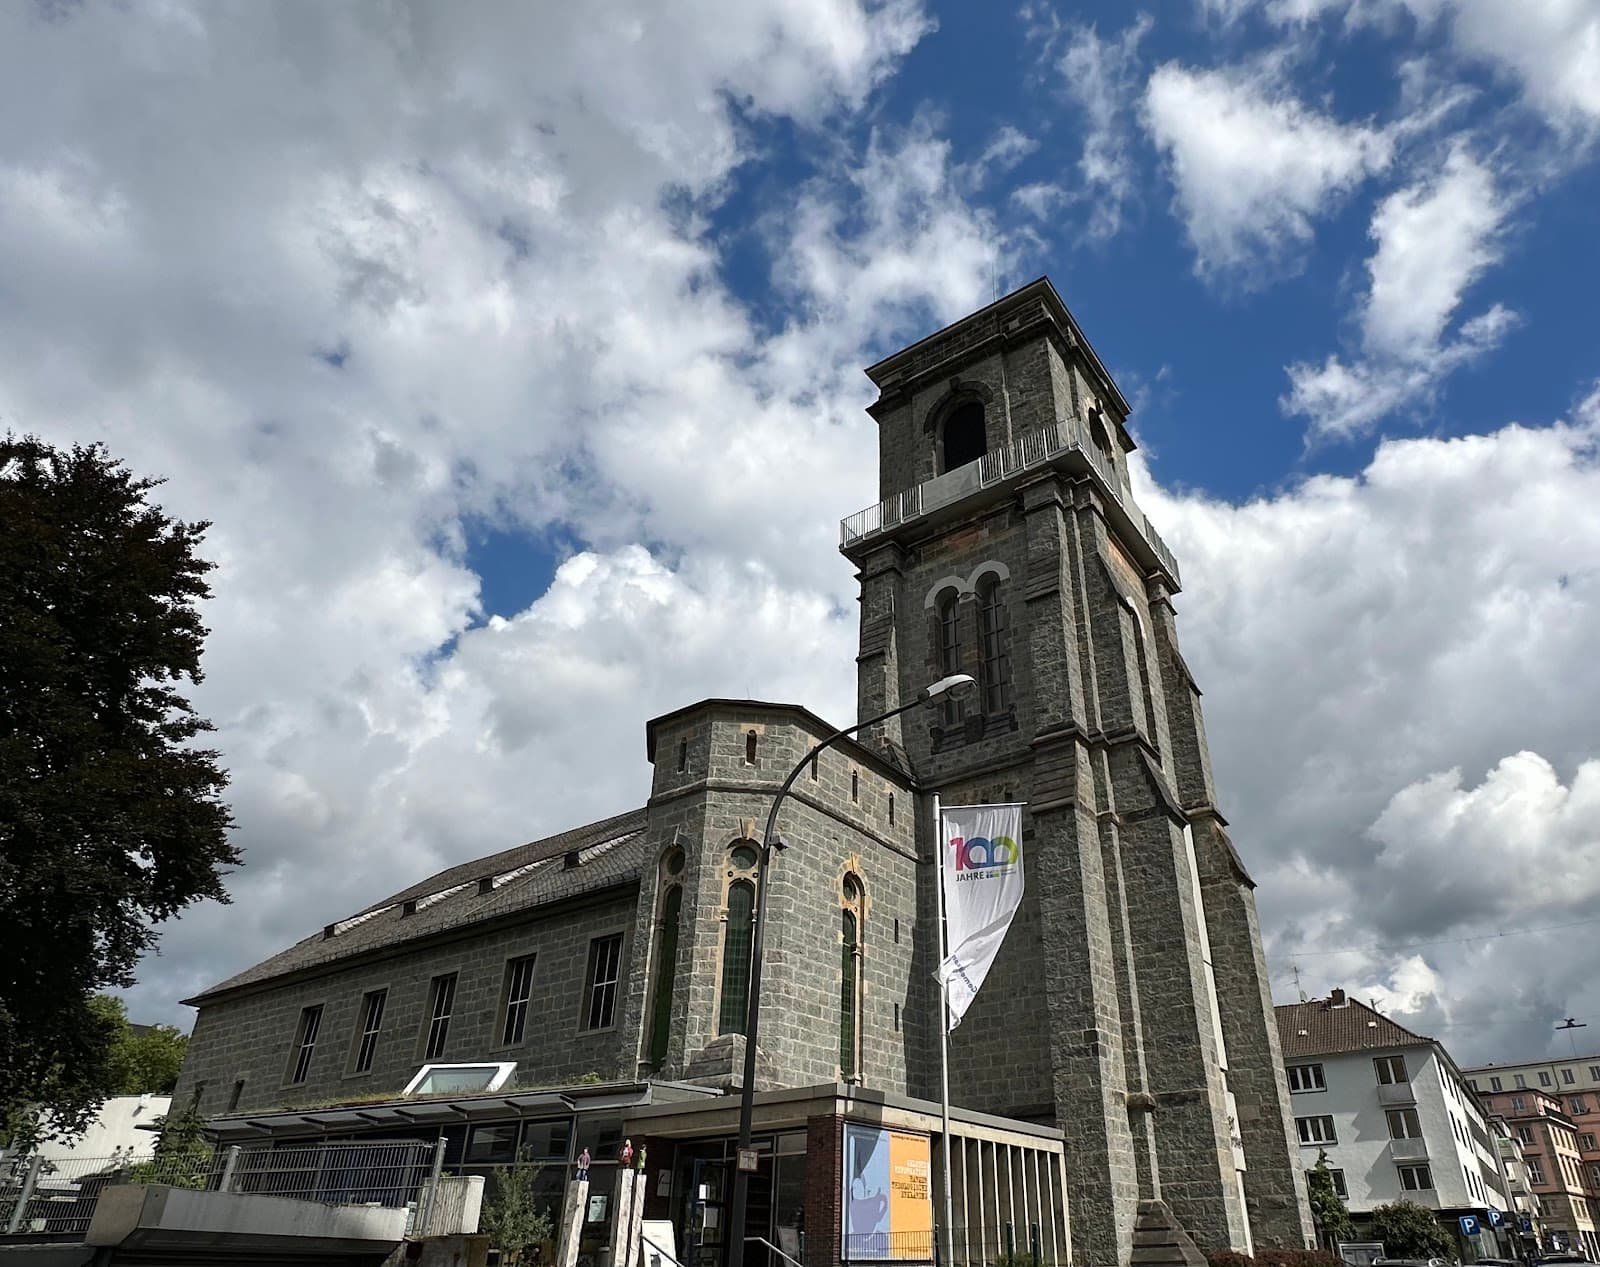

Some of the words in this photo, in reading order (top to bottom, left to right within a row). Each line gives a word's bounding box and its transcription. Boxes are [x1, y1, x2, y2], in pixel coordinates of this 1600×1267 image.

[949, 836, 1018, 871] 100
[956, 871, 984, 882] JAHRE
[1491, 1212, 1501, 1225] P
[1523, 1219, 1530, 1230] P
[1463, 1218, 1474, 1233] P
